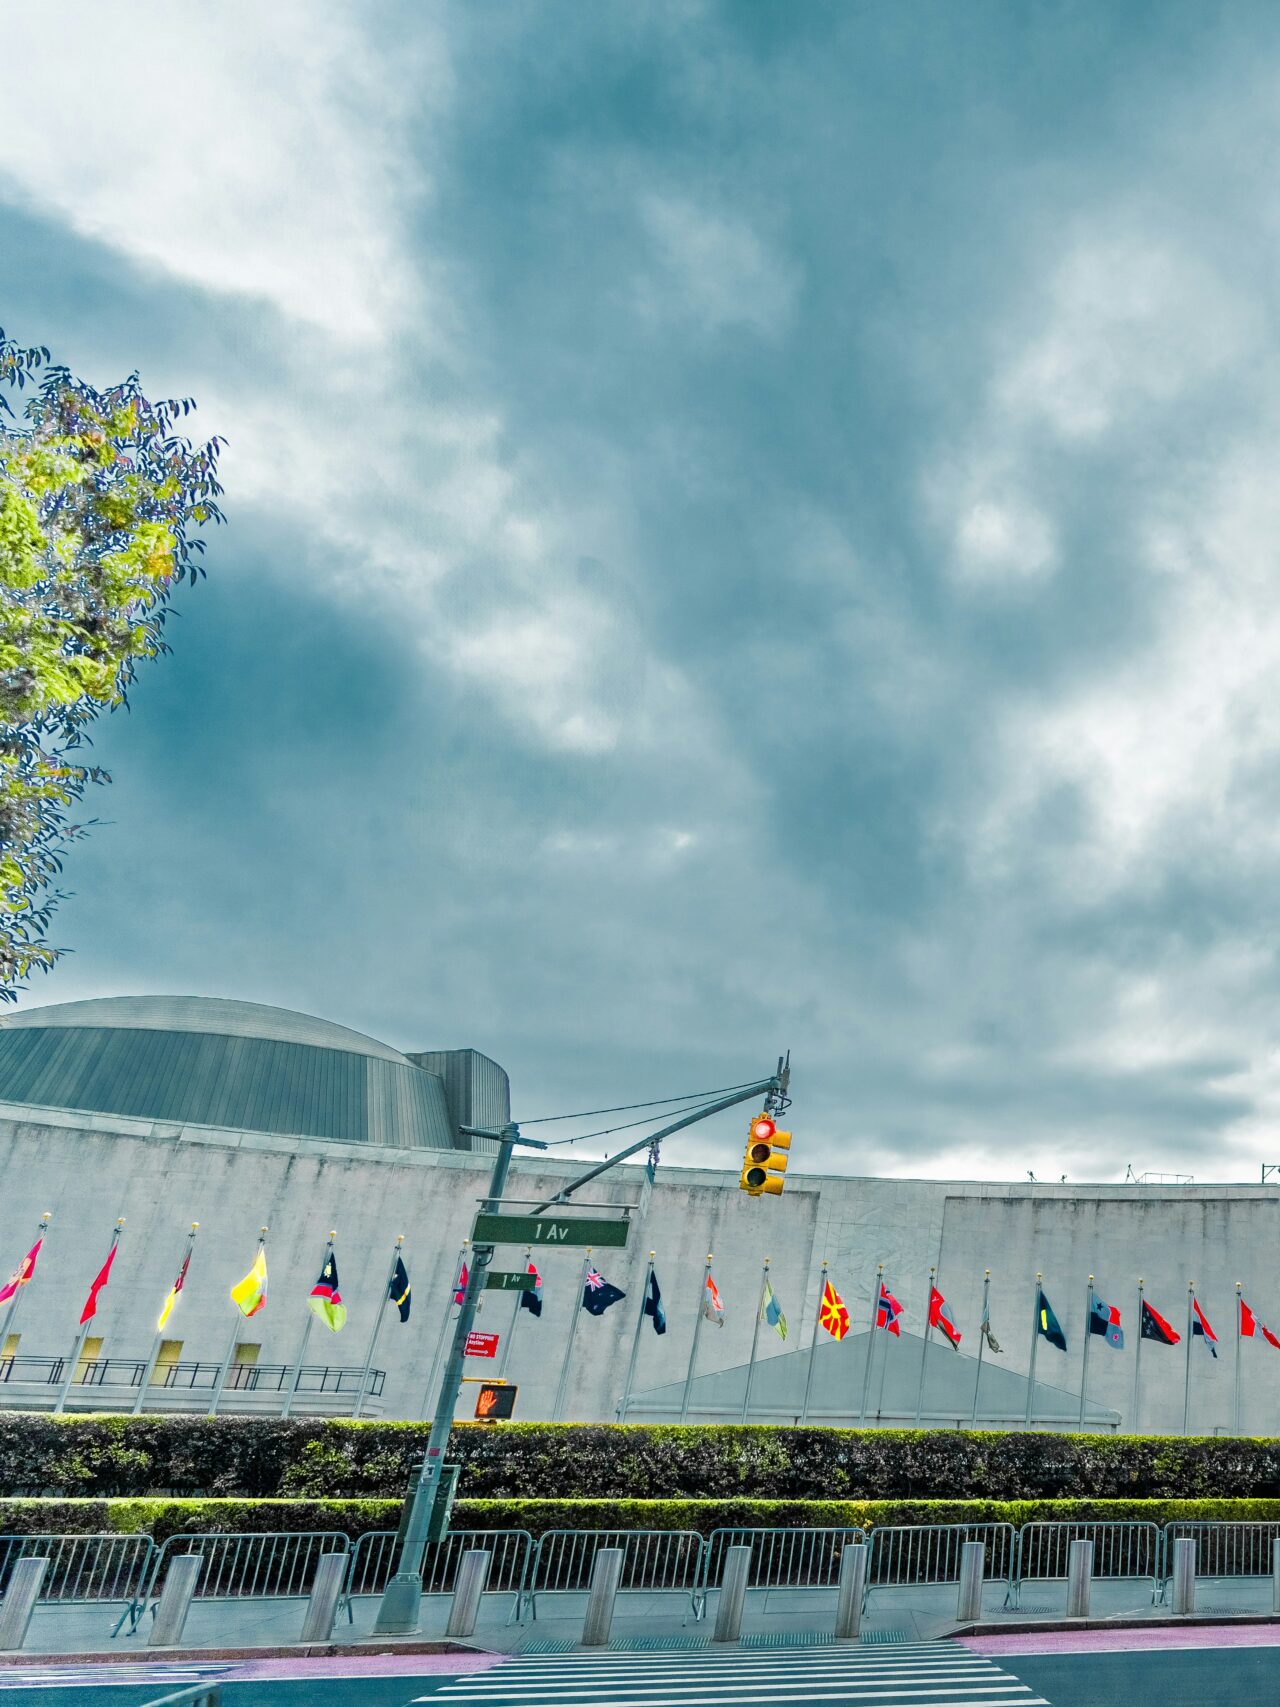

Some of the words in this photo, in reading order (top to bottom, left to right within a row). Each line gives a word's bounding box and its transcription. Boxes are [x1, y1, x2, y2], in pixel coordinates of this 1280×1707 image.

[535, 1223, 542, 1239] 1
[546, 1223, 569, 1240] Av
[502, 1274, 508, 1288] 1
[511, 1274, 521, 1283] Av
